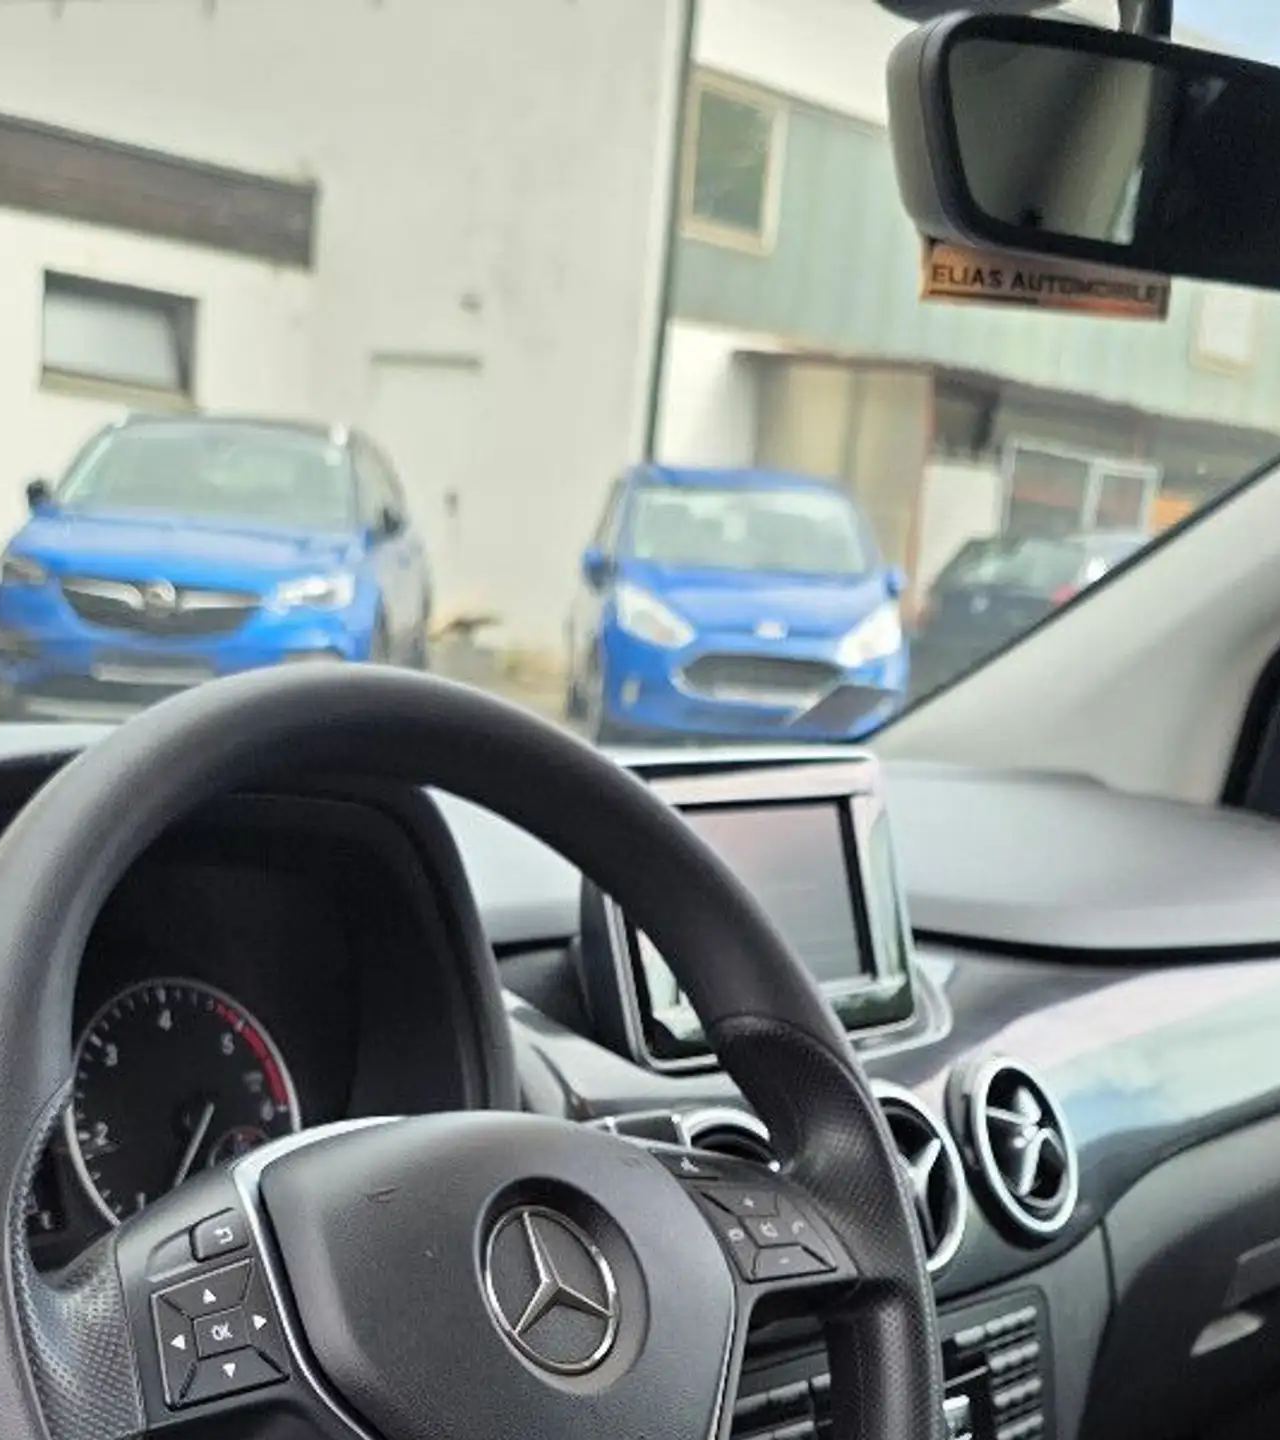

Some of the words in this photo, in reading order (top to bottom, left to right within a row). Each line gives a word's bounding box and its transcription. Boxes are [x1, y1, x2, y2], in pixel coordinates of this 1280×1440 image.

[931, 264, 1004, 289] ELIAS
[158, 1009, 173, 1031] 4
[105, 1043, 119, 1067] 3
[94, 1121, 109, 1146] 2
[210, 1322, 234, 1341] OK
